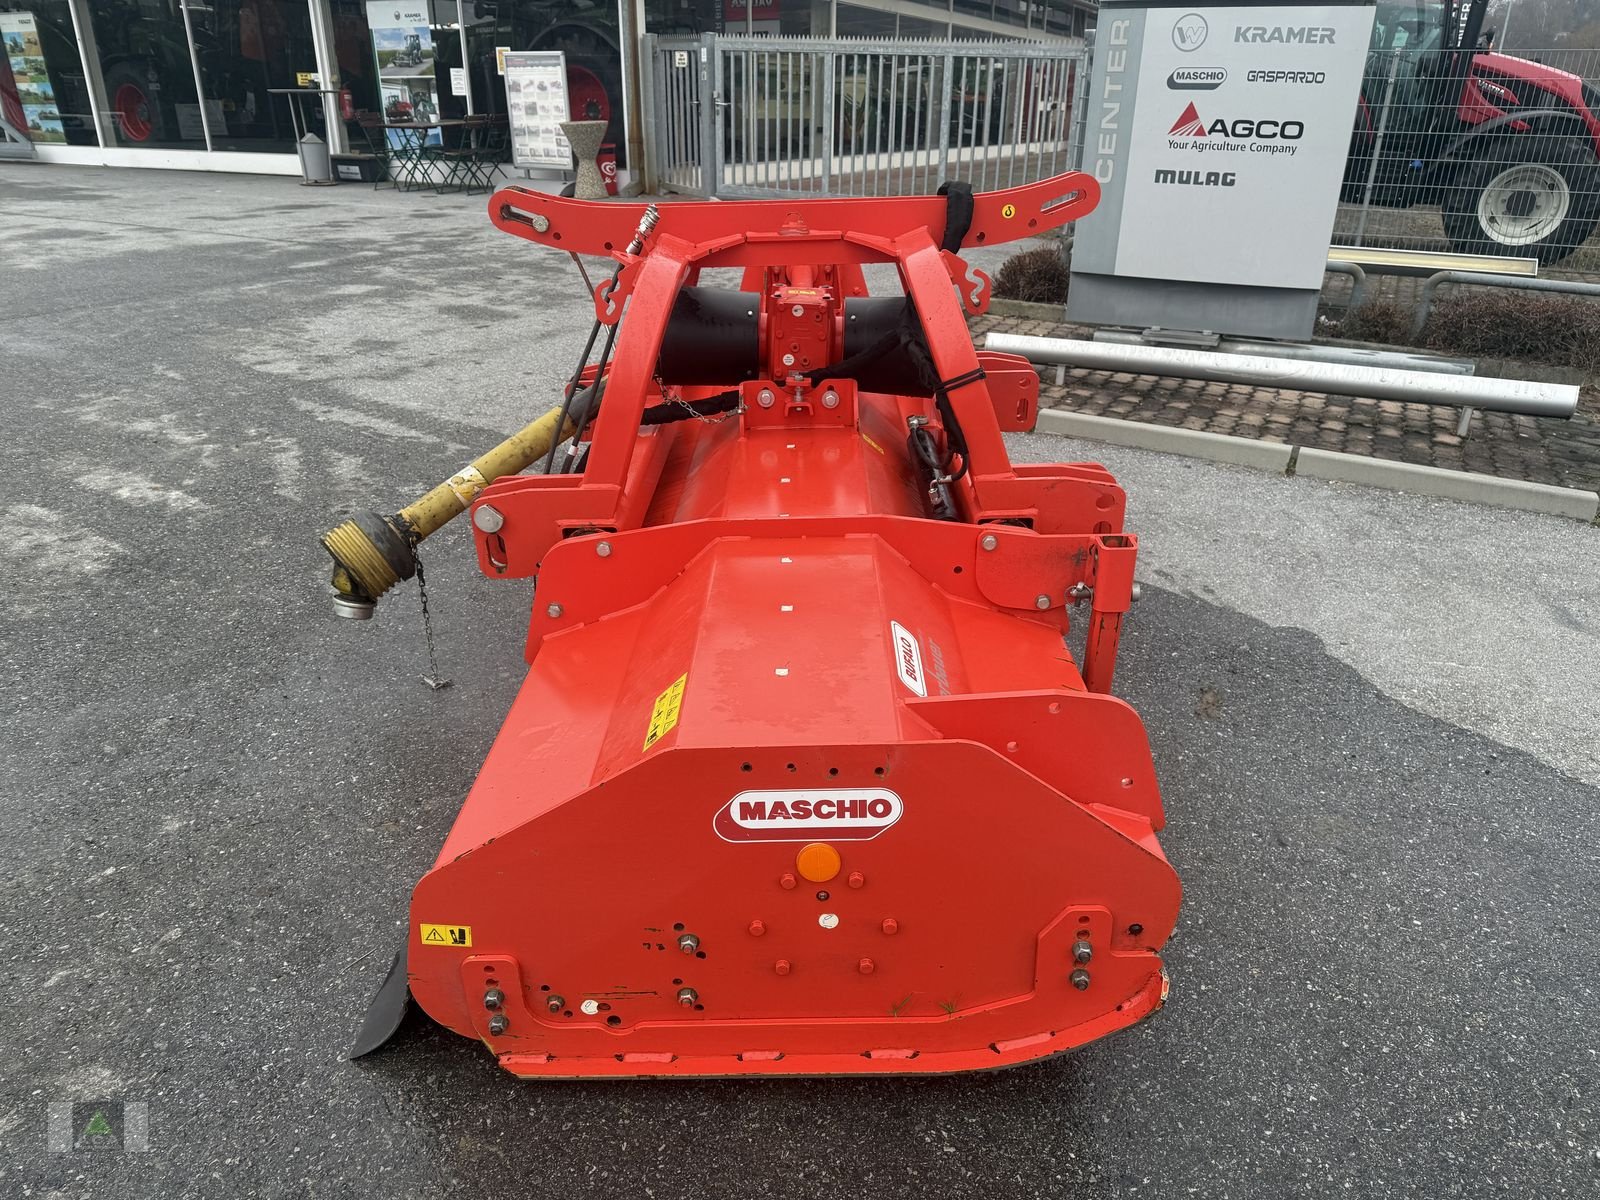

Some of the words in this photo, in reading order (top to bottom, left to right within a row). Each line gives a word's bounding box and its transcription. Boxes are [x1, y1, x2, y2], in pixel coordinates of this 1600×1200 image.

[1234, 26, 1336, 45] KRAMER
[1176, 71, 1224, 82] MASCHIO
[1246, 70, 1326, 84] GASPARDO
[1095, 19, 1130, 184] CENTER
[1208, 119, 1304, 139] AGCO
[1168, 140, 1189, 150] Your
[1191, 141, 1246, 153] Agriculture
[1249, 142, 1298, 156] Company
[1155, 169, 1236, 187] MULAG
[900, 636, 918, 682] BUFALO
[739, 798, 893, 821] MASCHIO
